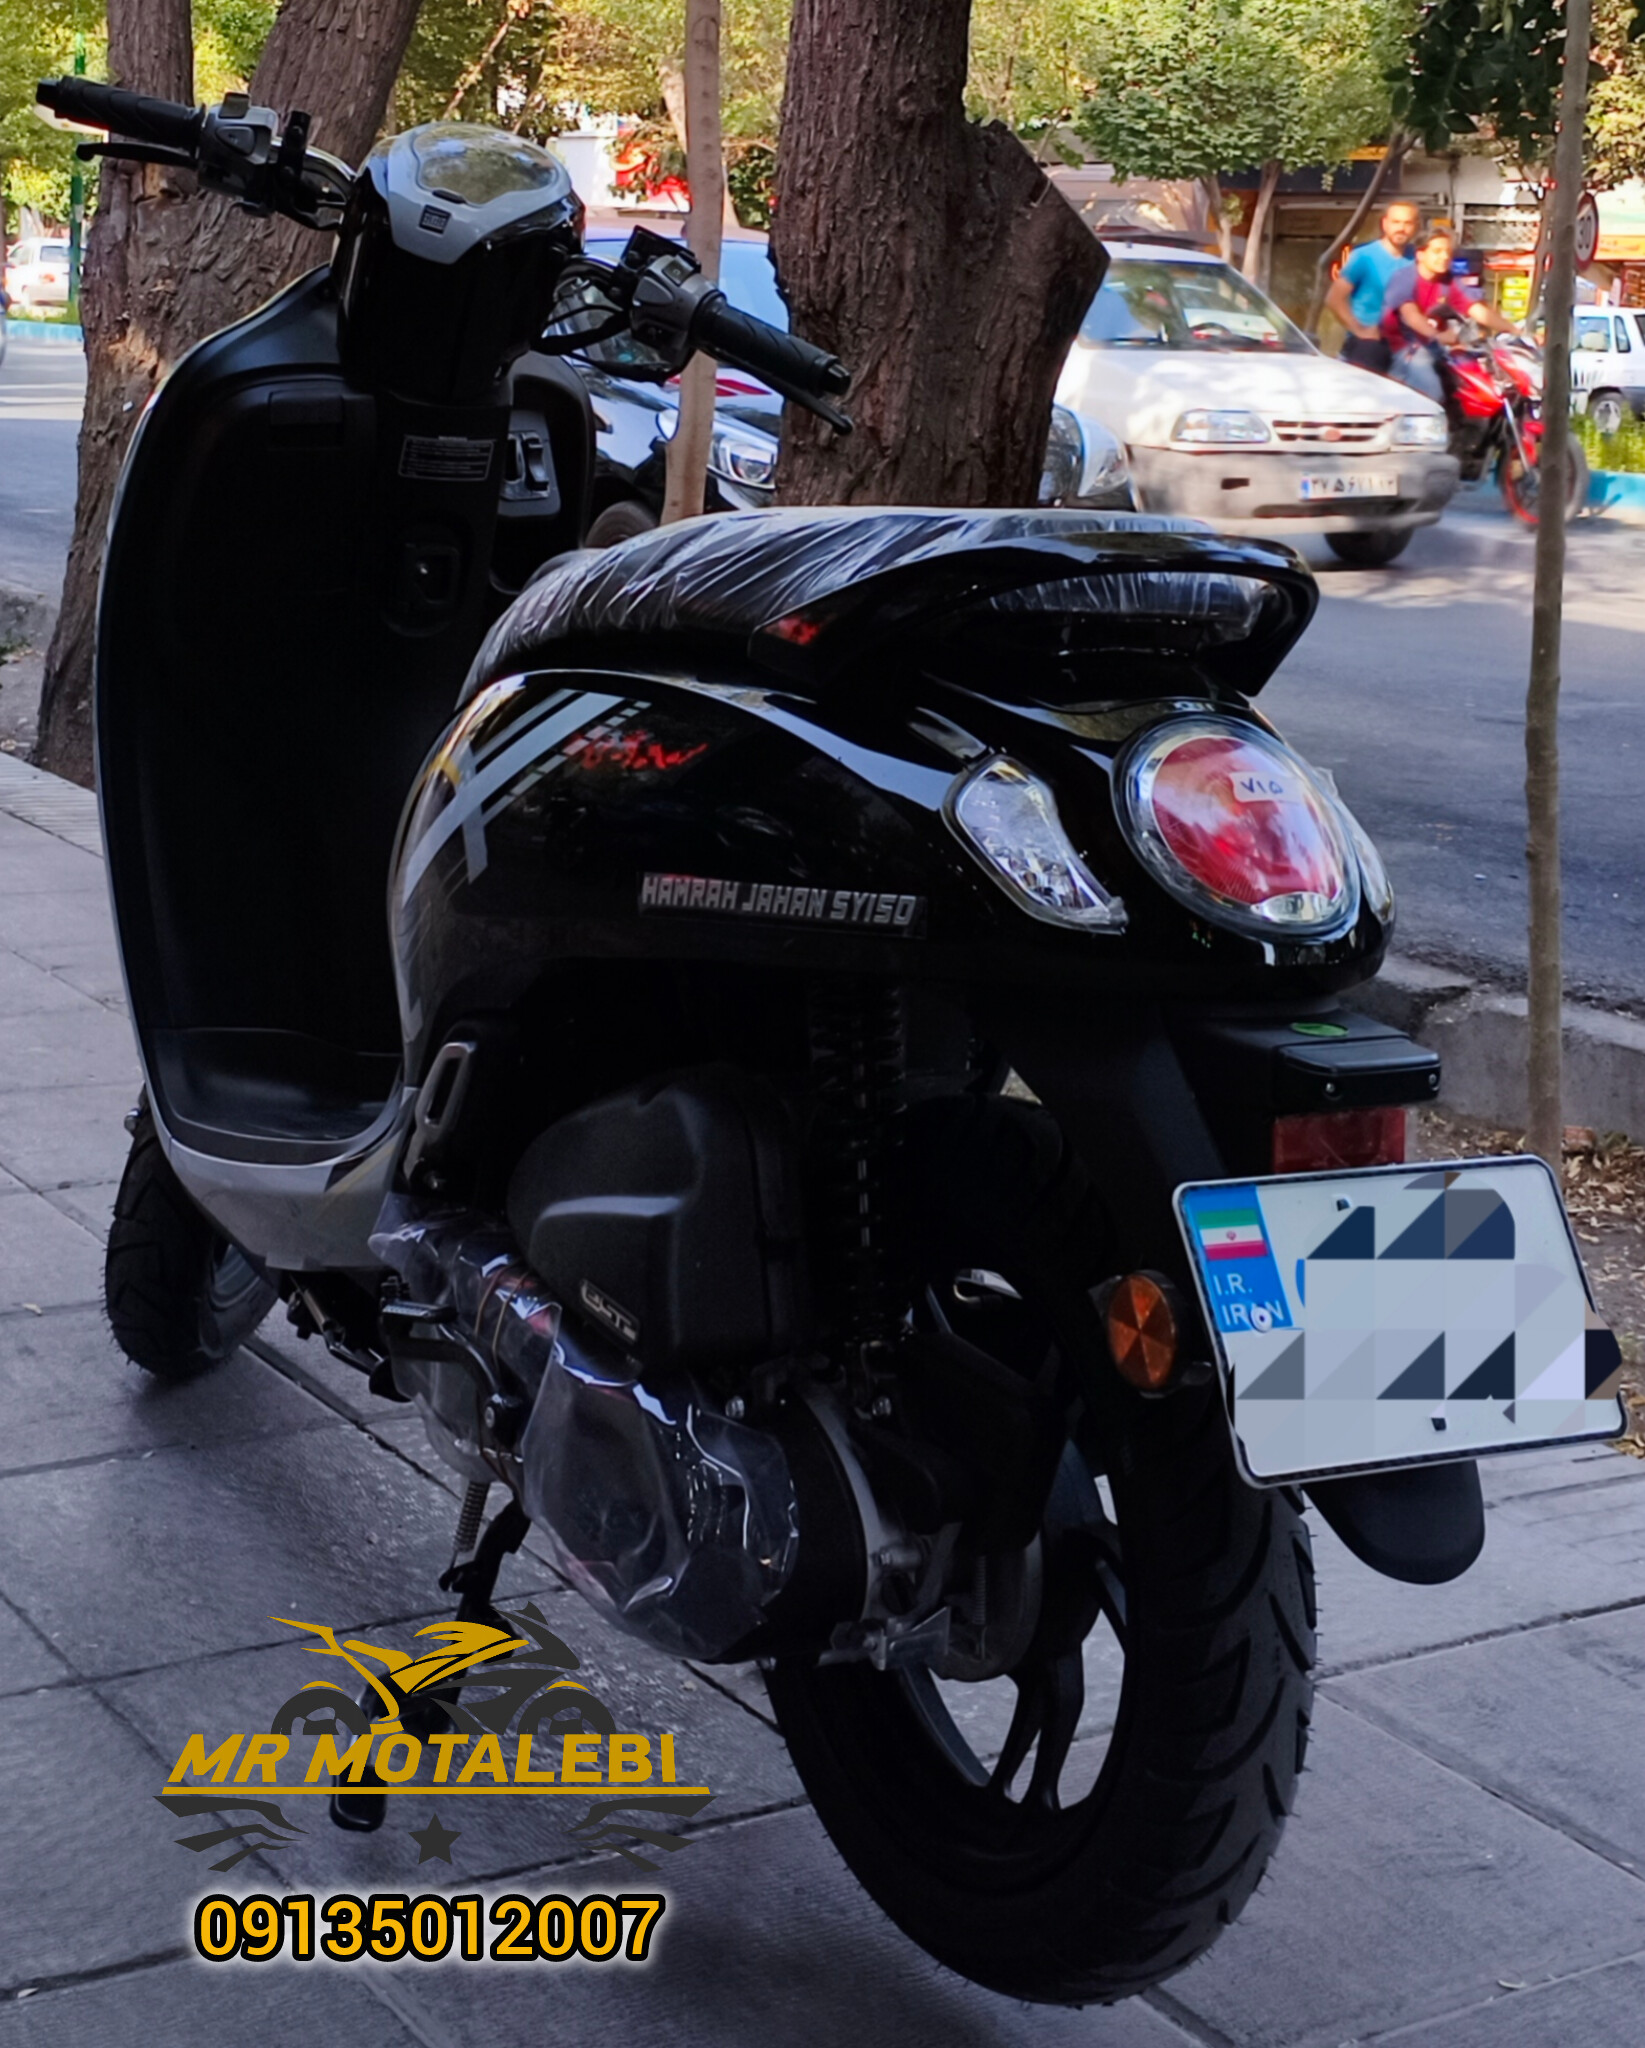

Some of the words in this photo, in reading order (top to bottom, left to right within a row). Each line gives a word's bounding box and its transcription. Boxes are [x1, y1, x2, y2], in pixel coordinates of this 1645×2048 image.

[642, 876, 739, 910] HAMRAH
[742, 883, 827, 918] JAHAN
[1213, 1272, 1253, 1296] I.R.
